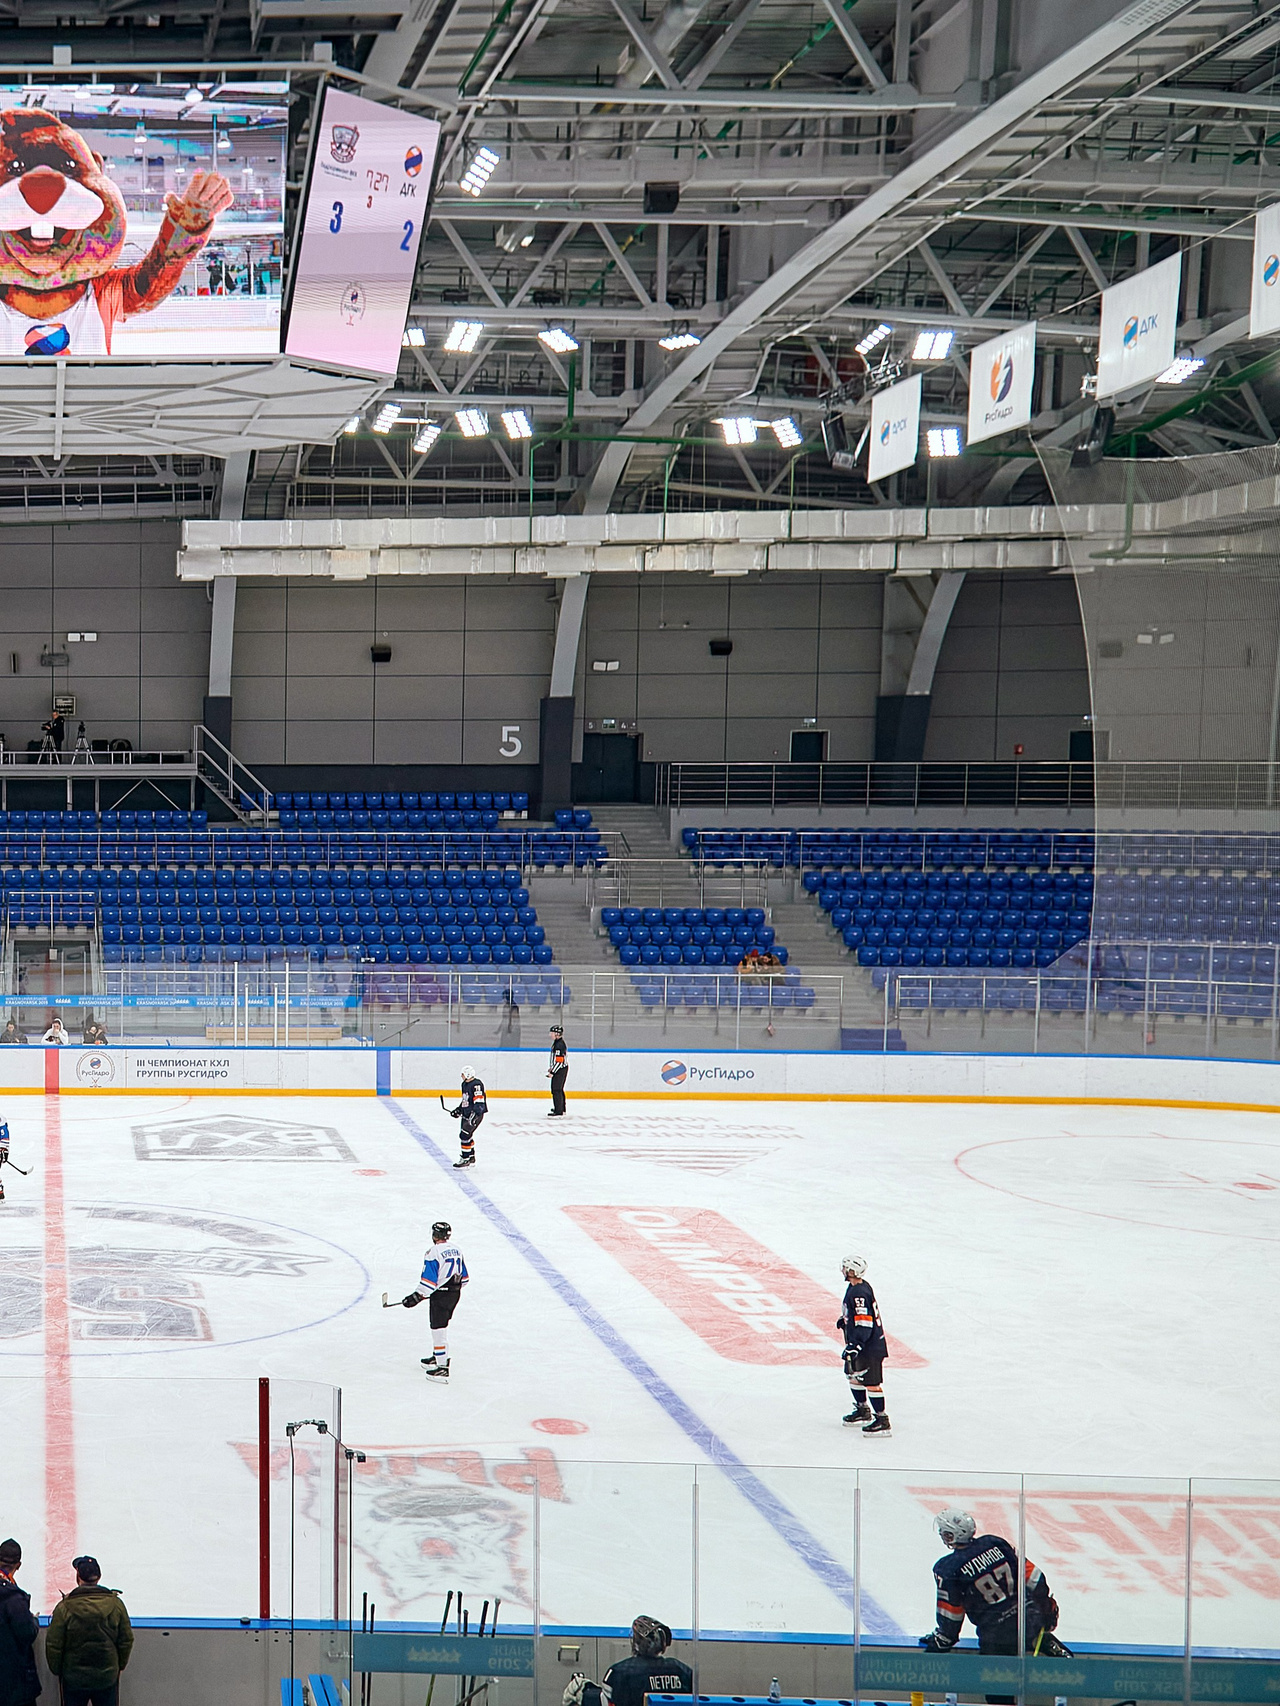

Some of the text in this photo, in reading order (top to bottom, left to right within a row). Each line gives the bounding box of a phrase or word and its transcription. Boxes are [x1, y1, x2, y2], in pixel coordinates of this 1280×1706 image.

[400, 182, 417, 198] ДГК
[366, 195, 373, 208] 3
[329, 201, 344, 234] 3
[400, 220, 414, 252] 2
[1139, 313, 1158, 337] ДГК
[499, 725, 522, 757] 5
[147, 1059, 207, 1067] ЧЕМПИОНАТ
[210, 1059, 230, 1067] КХЛ
[136, 1070, 228, 1079] ГРУППЫ РУСГИДРО
[690, 1067, 755, 1081] РусГидро
[145, 1130, 333, 1150] ВХЛ
[444, 1257, 461, 1278] 71
[619, 1209, 848, 1357] OLIMPBET
[854, 1297, 865, 1307] 53
[960, 1546, 1004, 1577] ЧУДИНОВ
[974, 1561, 1014, 1604] 87
[649, 1675, 682, 1691] ПЕТРОВ
